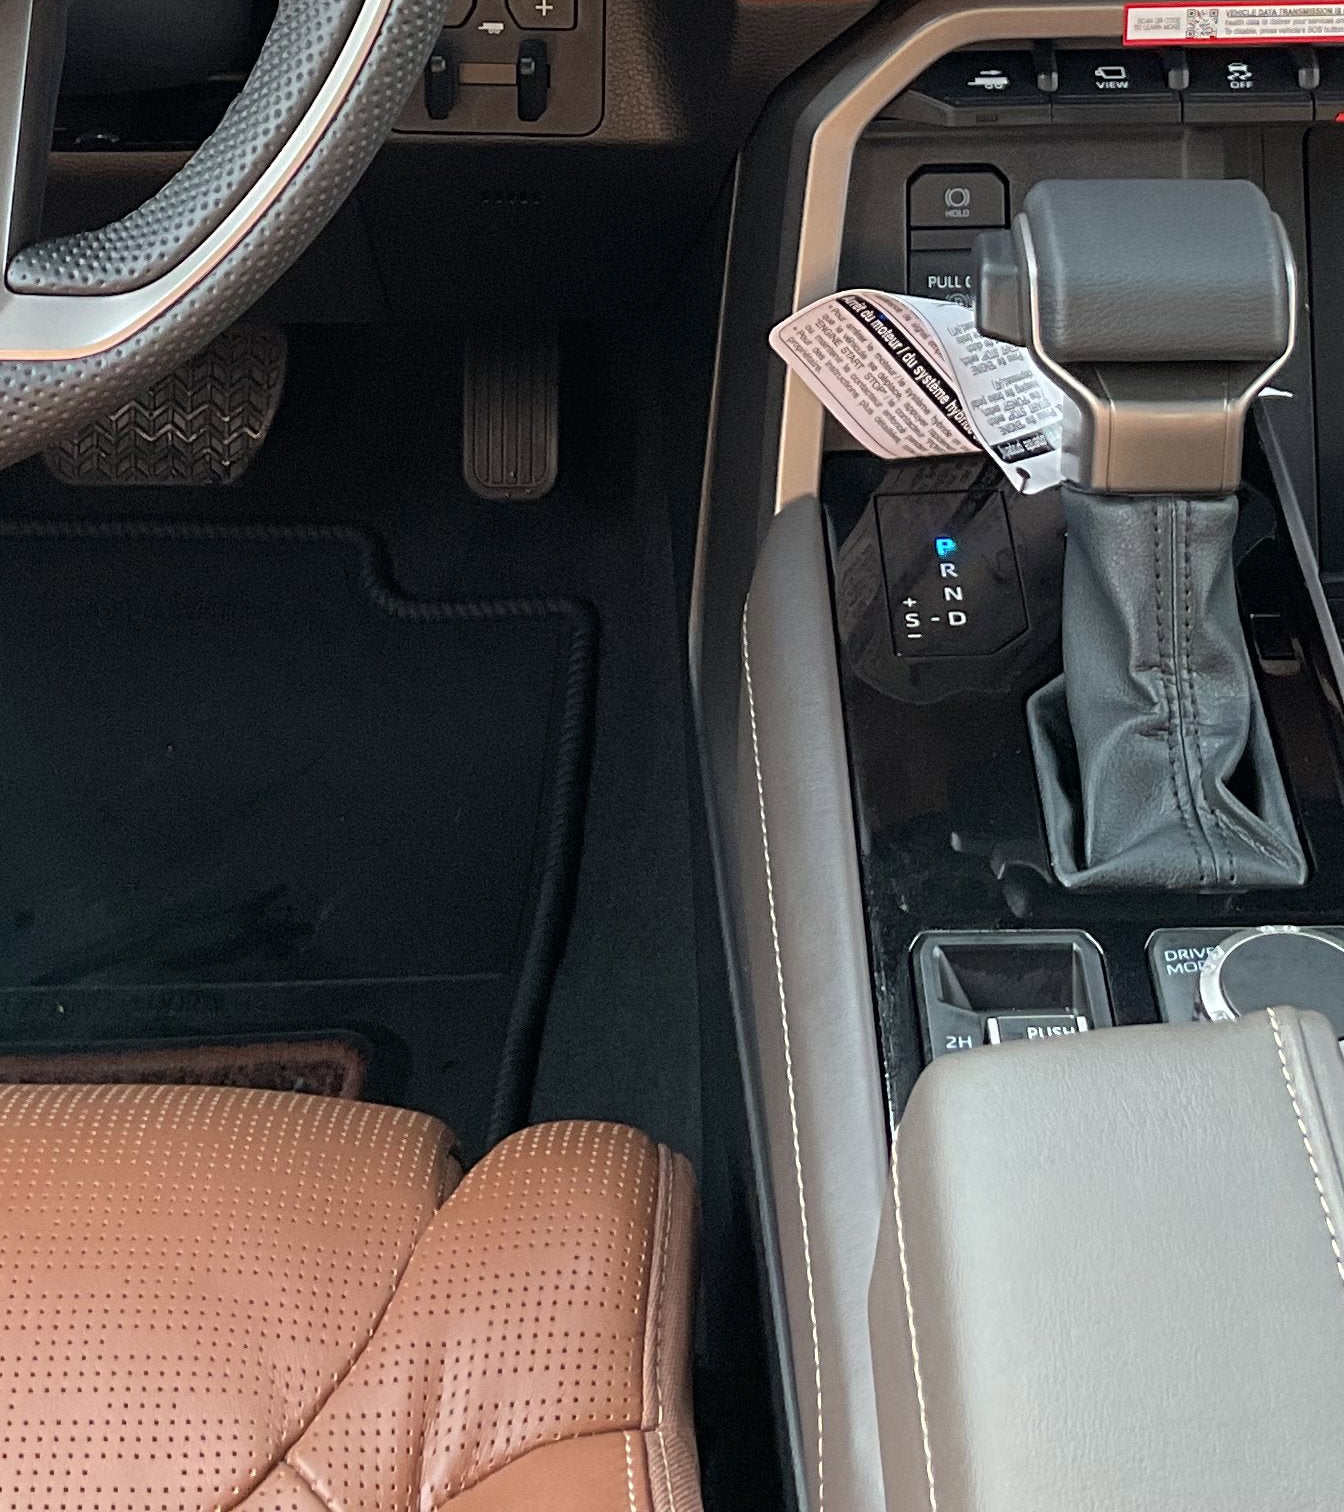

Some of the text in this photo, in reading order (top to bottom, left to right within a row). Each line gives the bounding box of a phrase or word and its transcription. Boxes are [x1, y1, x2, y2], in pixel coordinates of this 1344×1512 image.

[1094, 80, 1129, 90] VIEW
[1229, 80, 1253, 90] OFF
[927, 275, 962, 289] PULL
[910, 362, 954, 406] système
[934, 538, 957, 557] P
[939, 563, 959, 578] R
[943, 586, 963, 602] N
[905, 611, 967, 629] S D
[945, 1034, 973, 1049] 2H
